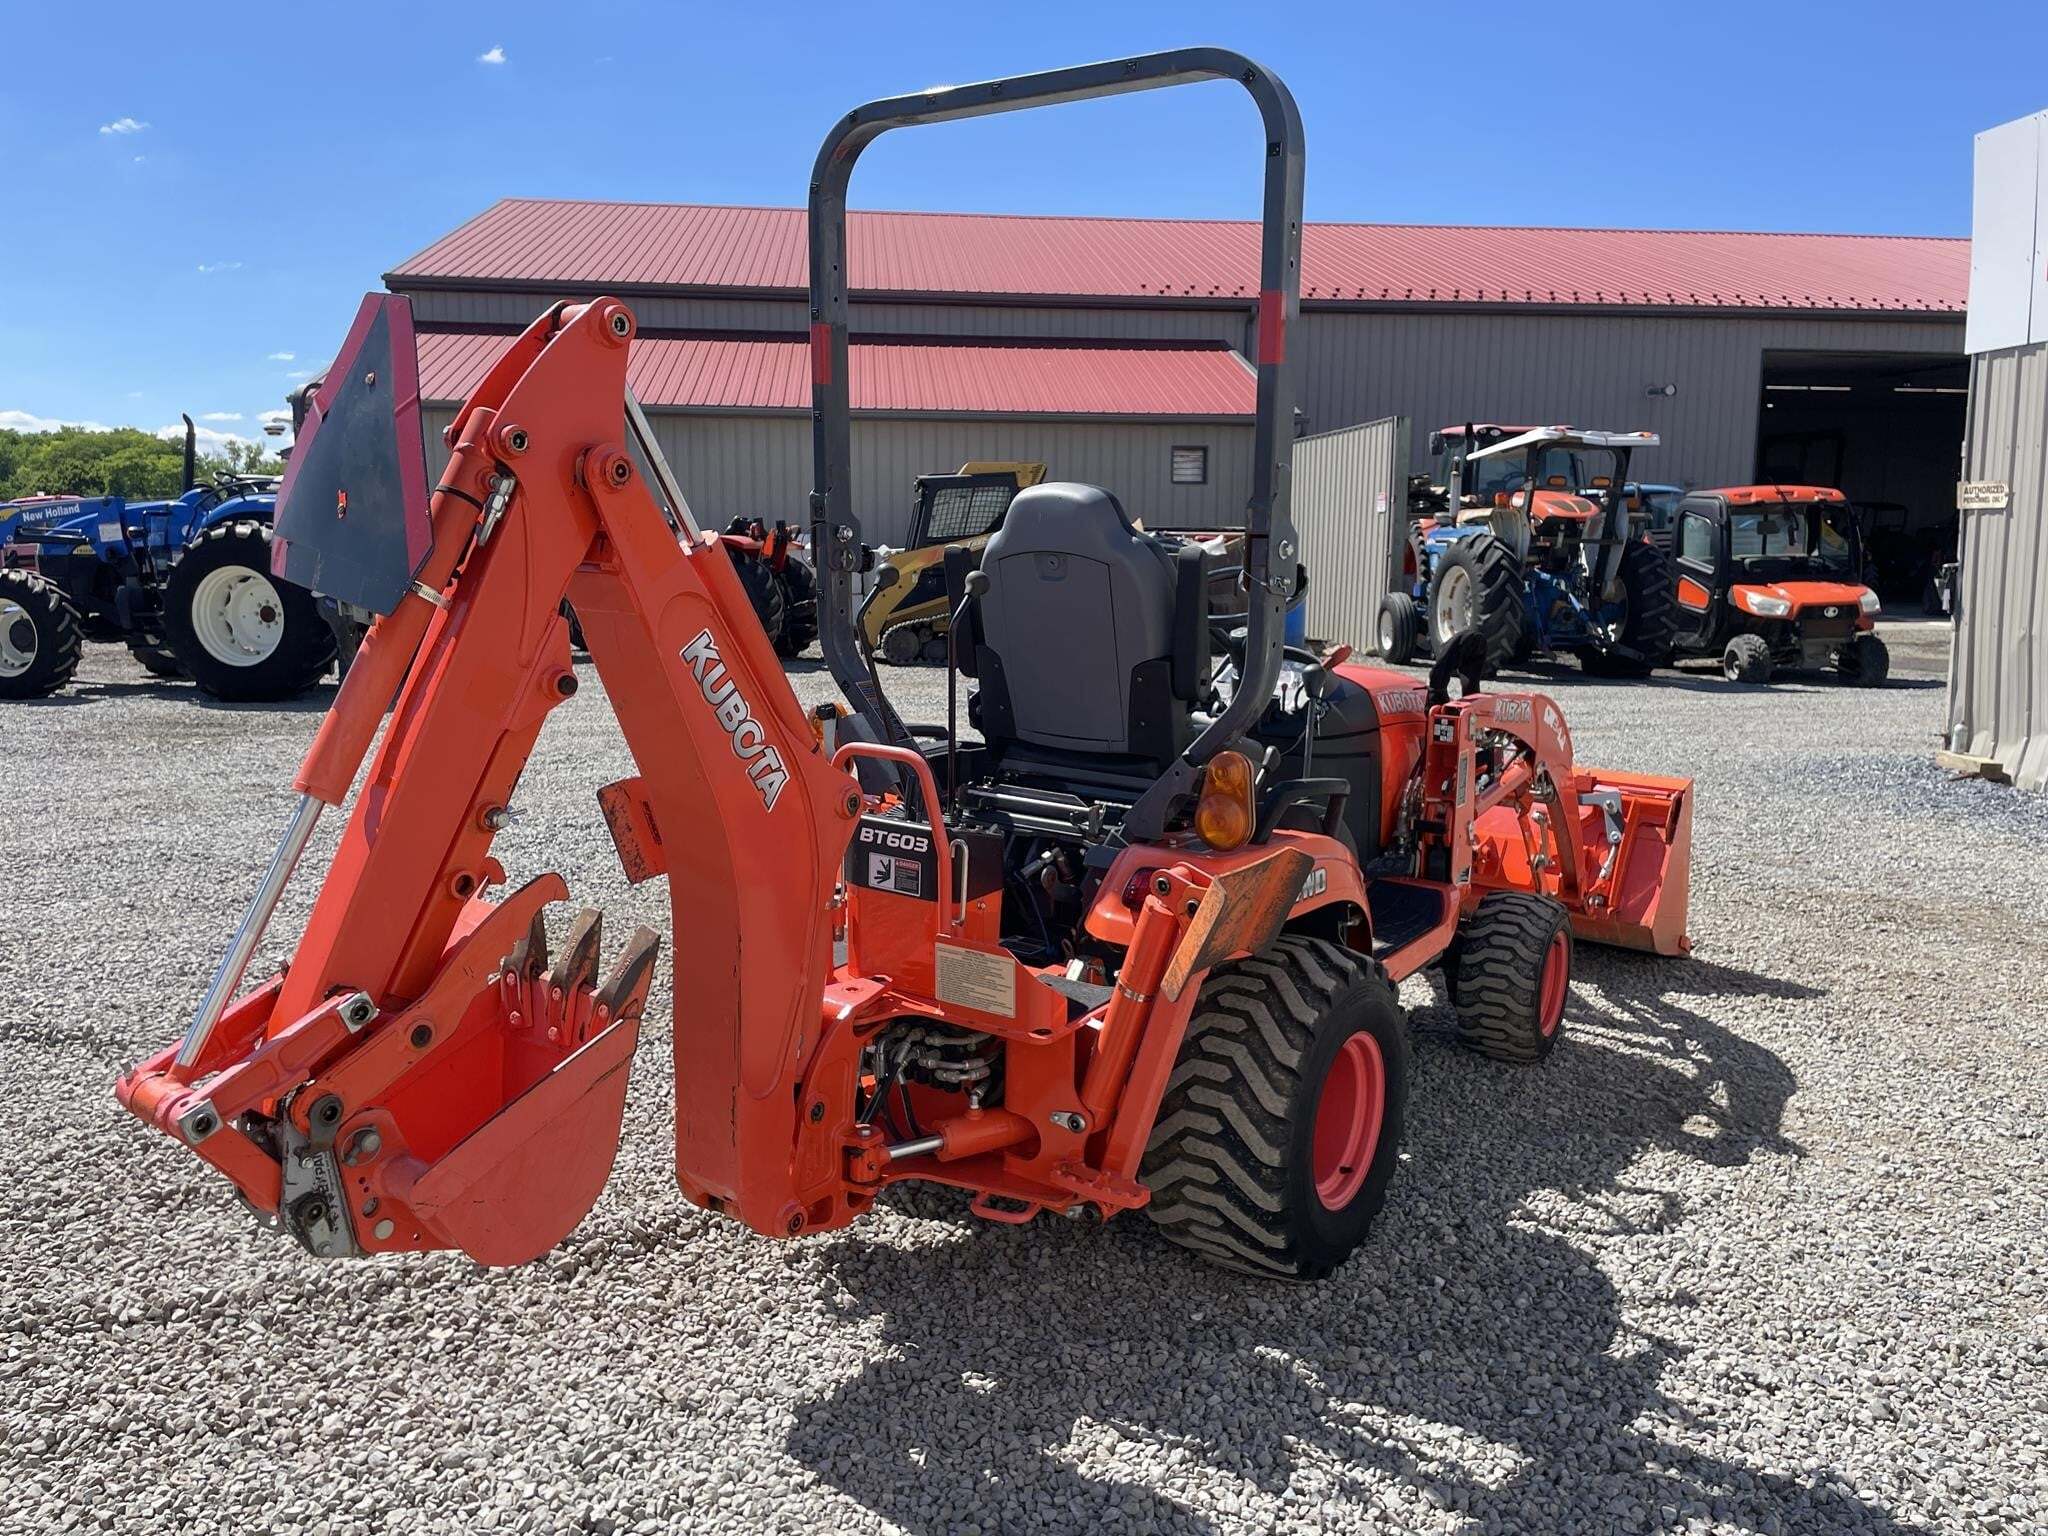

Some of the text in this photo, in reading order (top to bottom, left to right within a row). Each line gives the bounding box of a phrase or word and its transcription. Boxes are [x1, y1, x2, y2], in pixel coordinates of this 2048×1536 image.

[1964, 485, 2004, 494] AUTHORIZED
[22, 503, 80, 522] New Holland
[1376, 691, 1425, 713] KUBOTA
[679, 628, 790, 813] KUBOTA
[859, 827, 929, 853] BT603
[1296, 868, 1327, 901] WD
